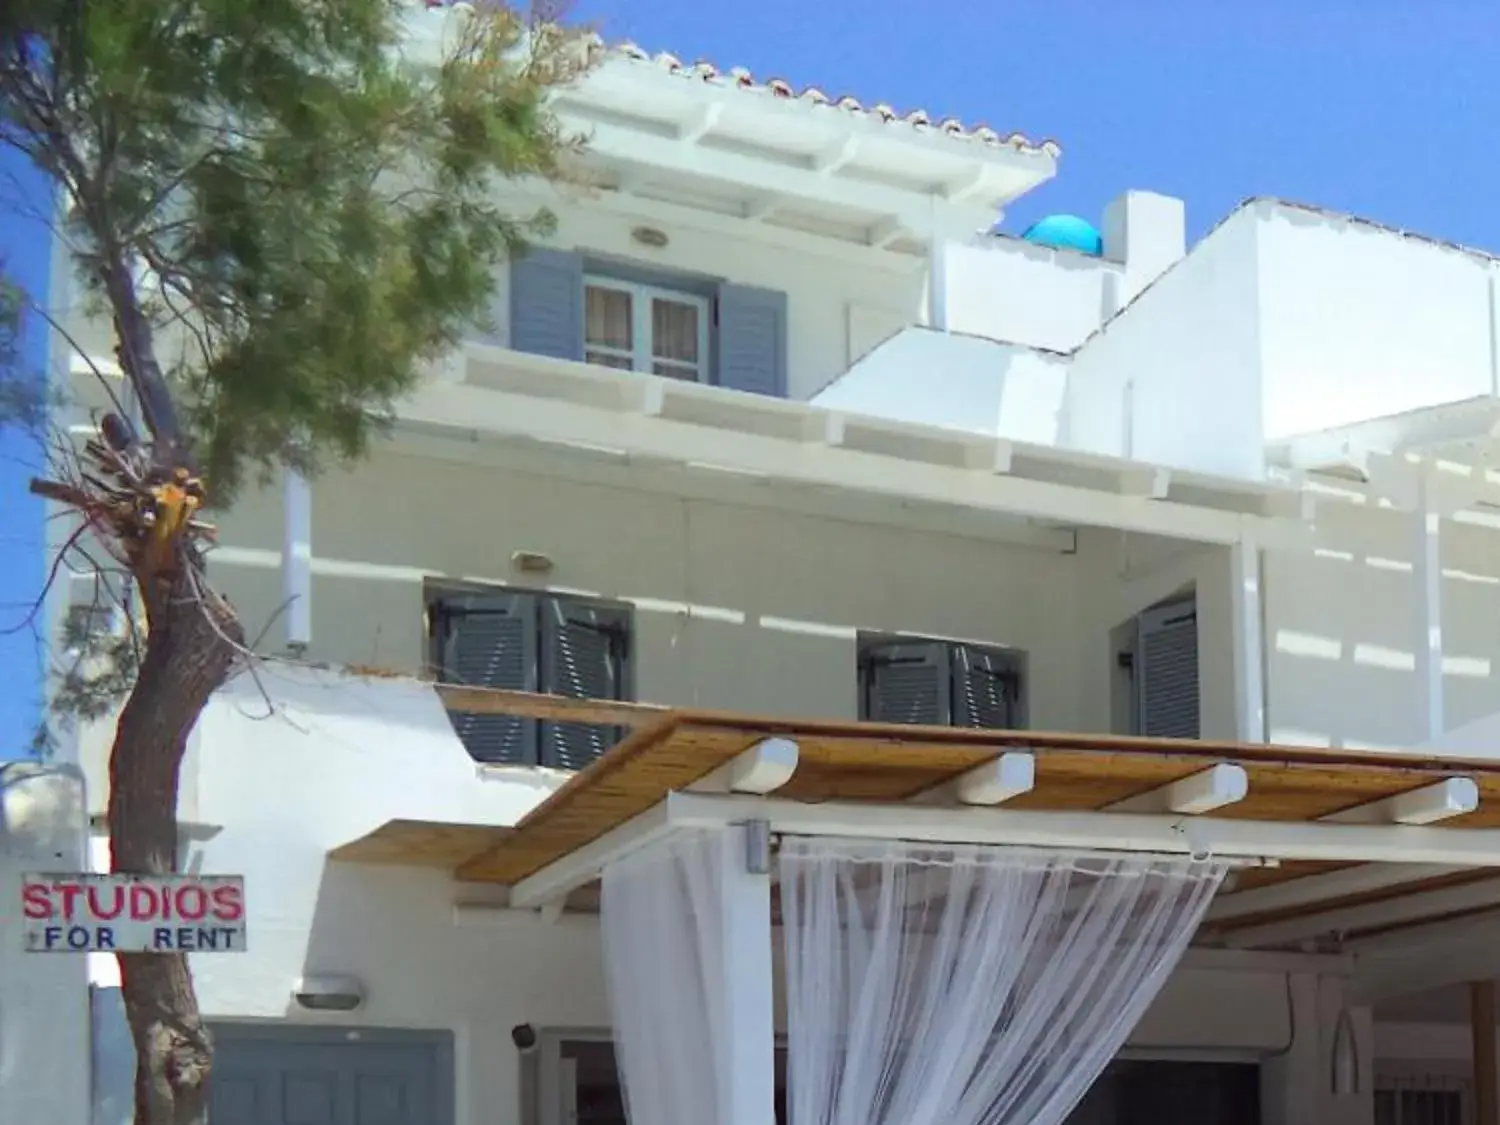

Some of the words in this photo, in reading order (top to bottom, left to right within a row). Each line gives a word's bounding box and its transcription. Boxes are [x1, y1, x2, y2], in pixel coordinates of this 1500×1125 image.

[22, 883, 243, 921] STUDIOS
[45, 926, 116, 948] FOR
[154, 927, 238, 949] RENT
